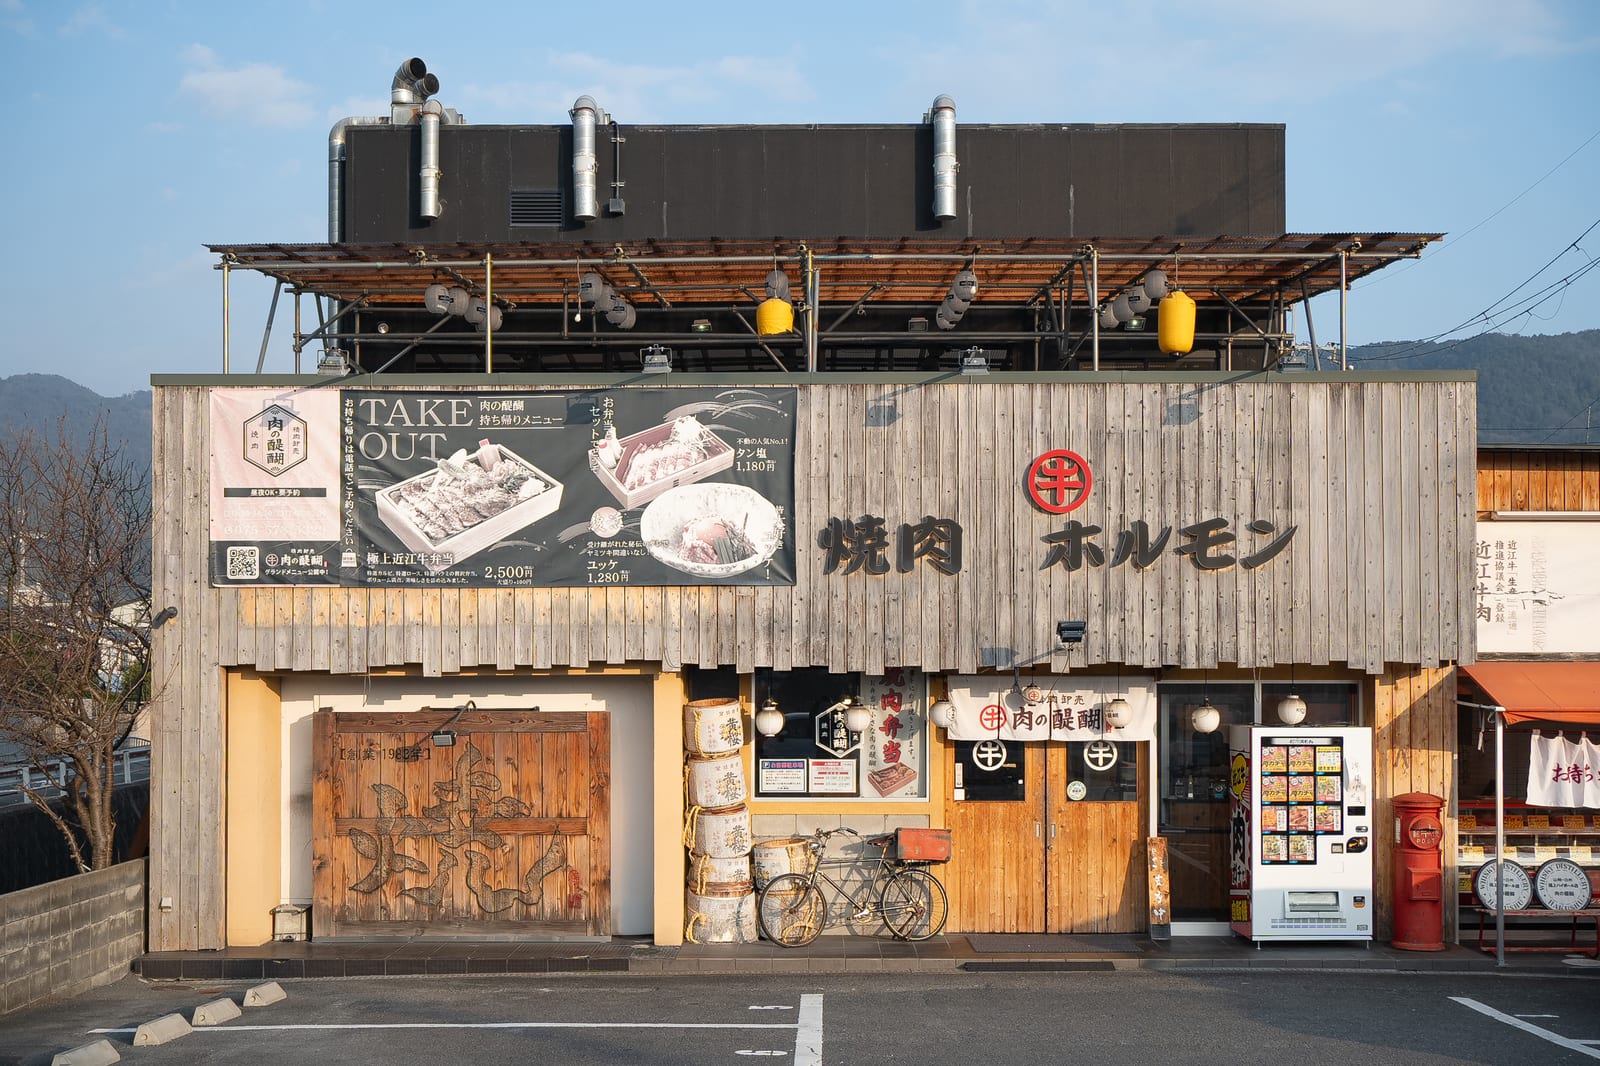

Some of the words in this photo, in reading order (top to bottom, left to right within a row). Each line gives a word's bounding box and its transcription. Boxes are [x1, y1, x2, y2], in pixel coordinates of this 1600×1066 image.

[359, 399, 474, 427] TAKE
[480, 401, 525, 412] 肉の醍醐
[479, 415, 563, 425] 持ち帰りメニュー
[266, 416, 285, 465] 肉の醍醐
[359, 431, 448, 461] OUT
[736, 447, 767, 459] タン塩
[736, 461, 775, 472] 1,180円
[823, 514, 964, 575] 焼肉
[1039, 518, 1298, 571] ホルモン
[484, 566, 533, 579] 2,500円
[587, 560, 618, 569] ユッケ
[587, 572, 630, 583] 1,280円
[1476, 540, 1492, 623] 近江牛肉
[1012, 706, 1101, 732] 肉の醍醐
[1551, 763, 1600, 785] お持ち
